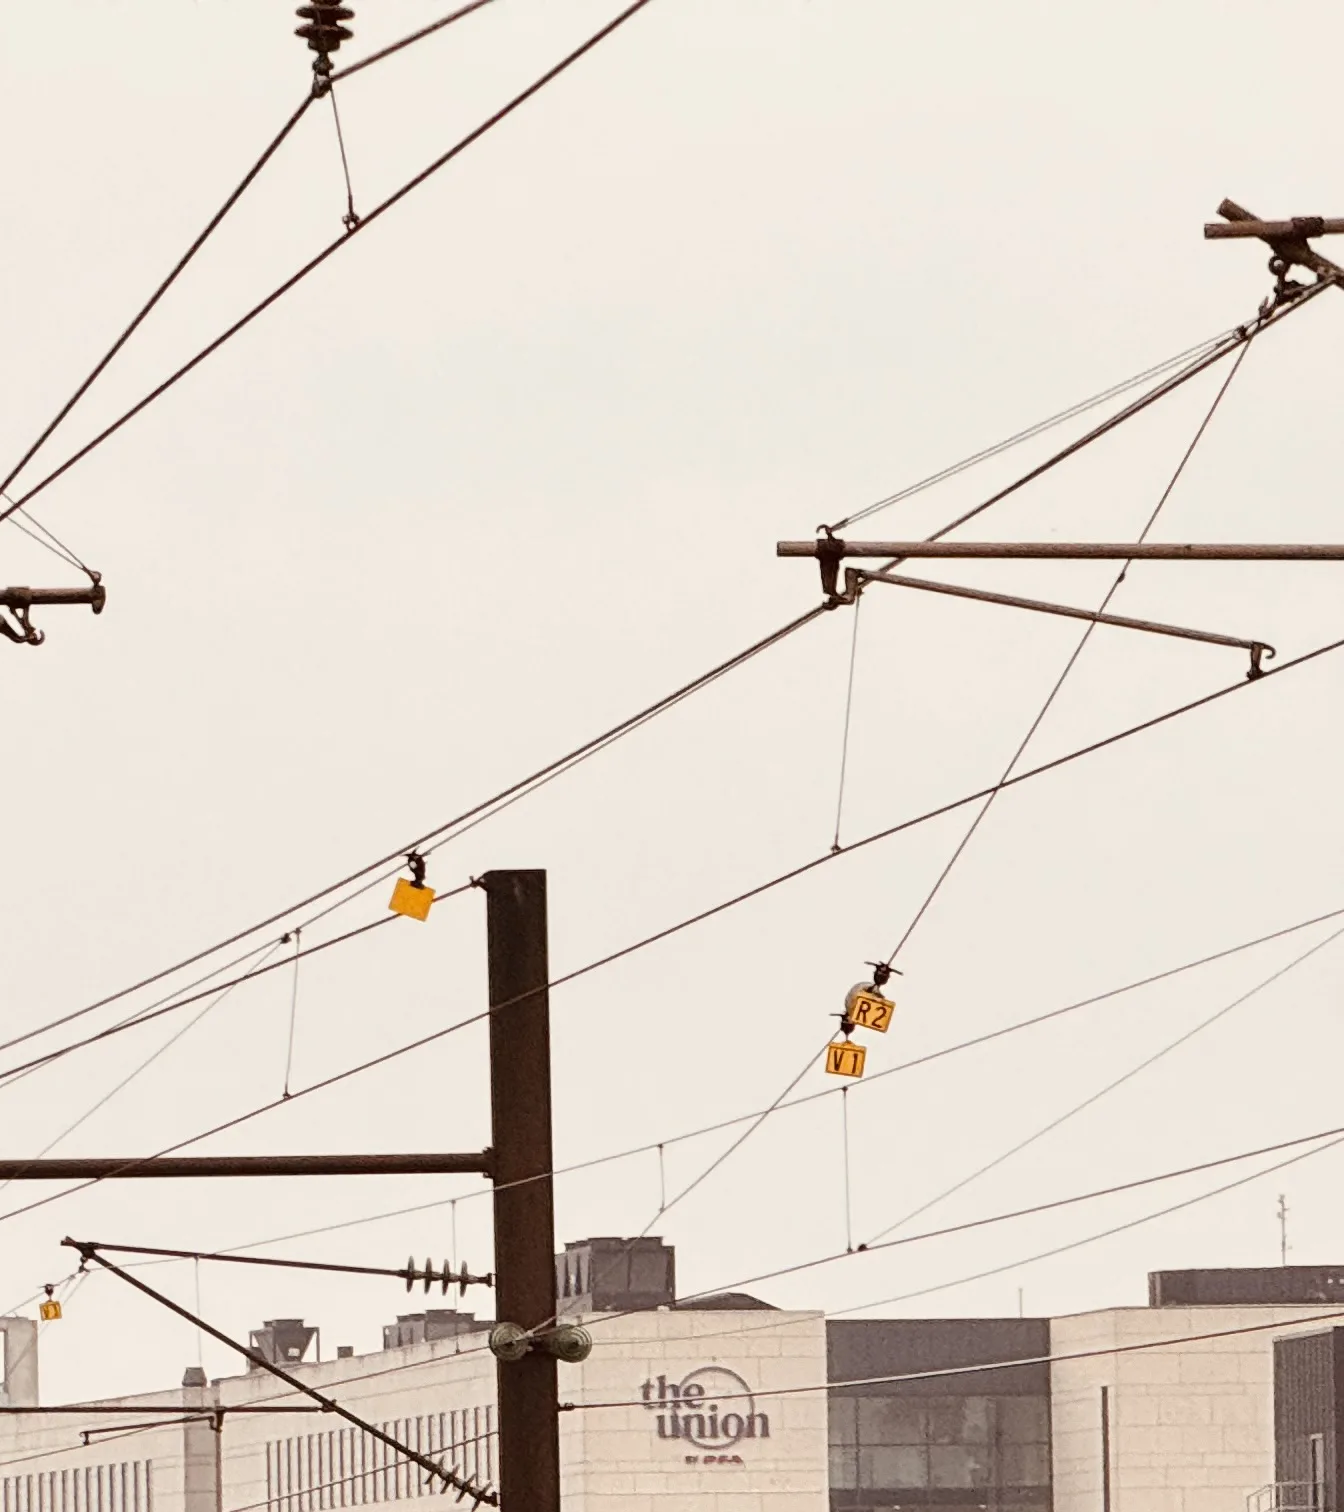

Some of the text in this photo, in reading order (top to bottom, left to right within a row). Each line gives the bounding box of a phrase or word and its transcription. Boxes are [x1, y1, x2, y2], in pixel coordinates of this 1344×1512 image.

[855, 1000, 887, 1028] R2
[833, 1049, 859, 1074] V1
[640, 1375, 706, 1409] the
[655, 1403, 770, 1439] union
